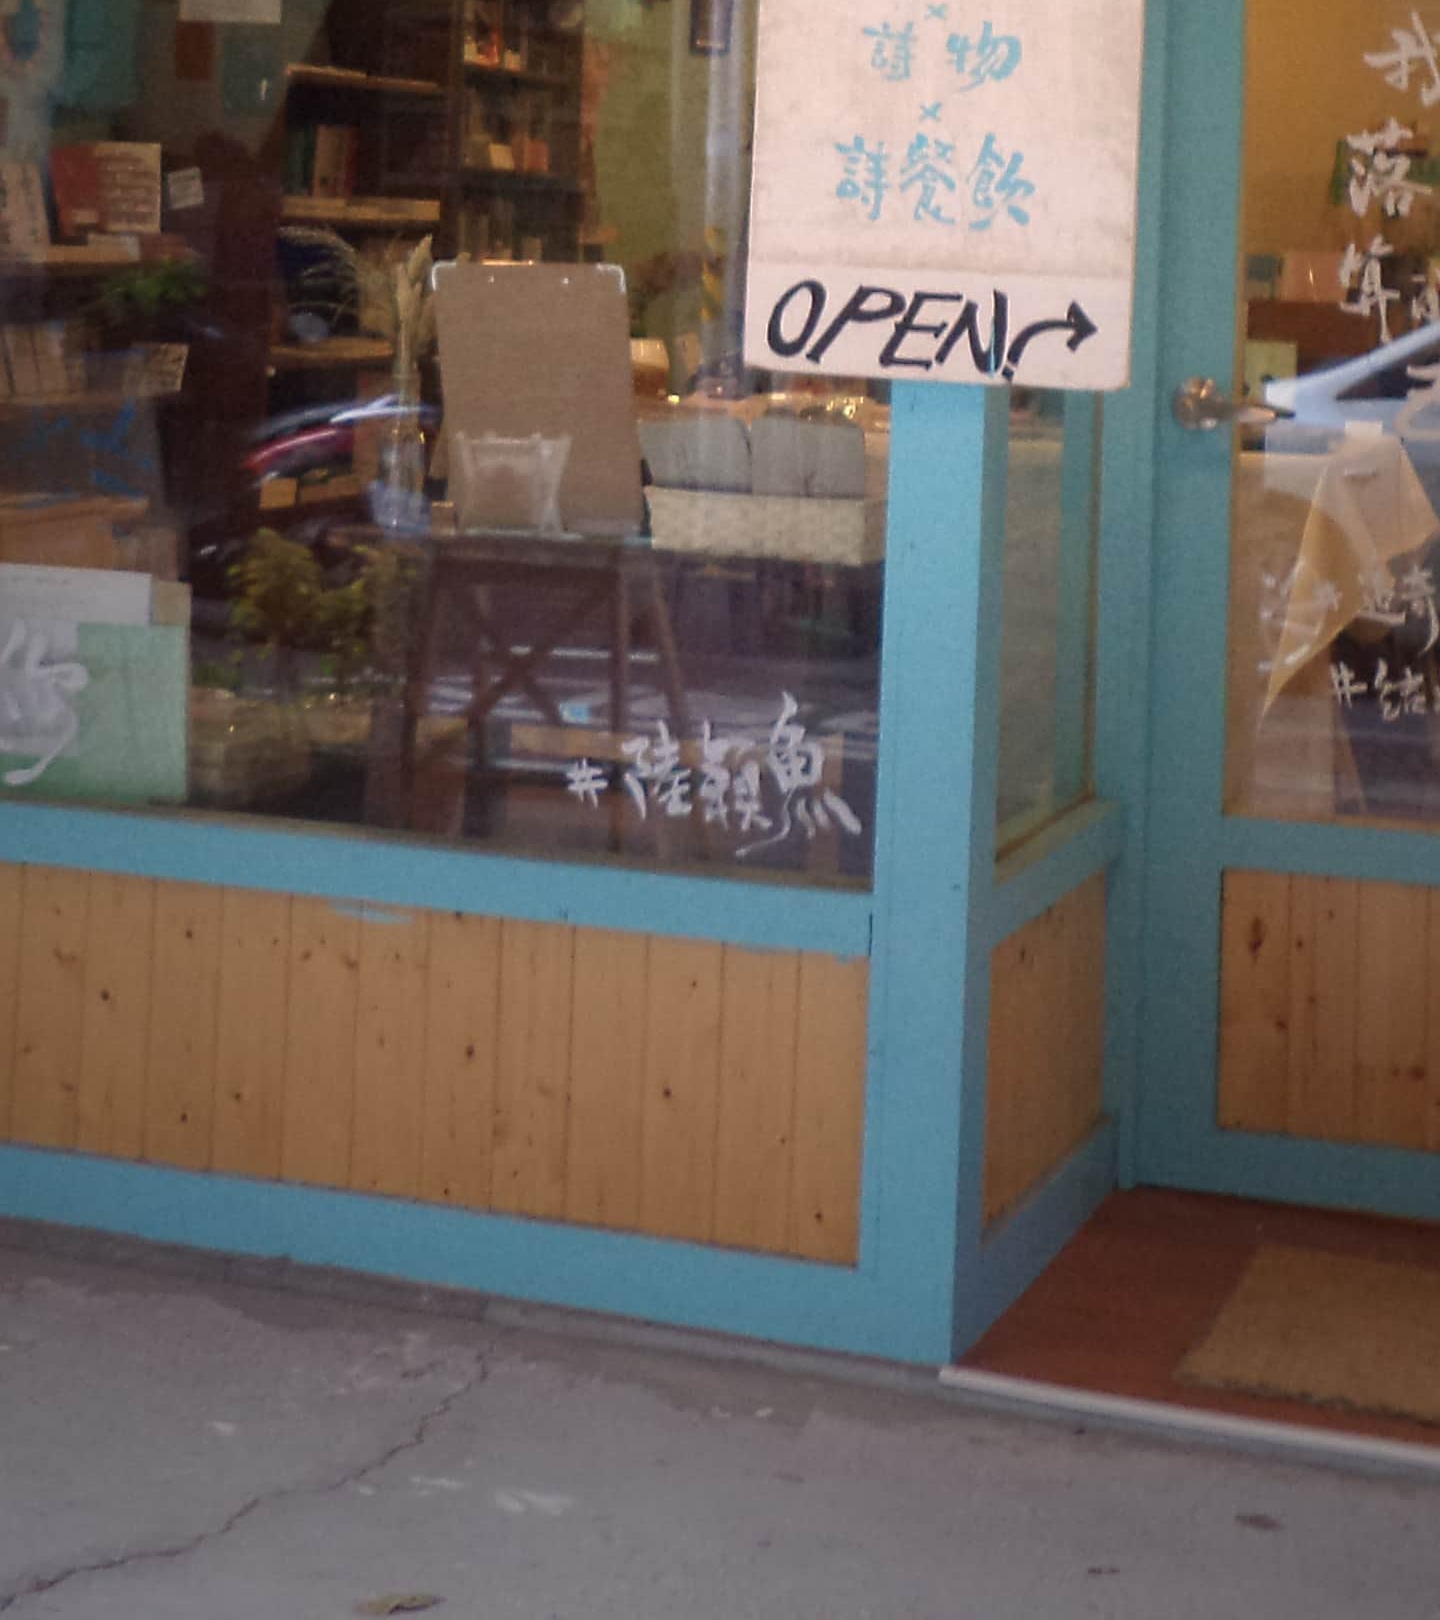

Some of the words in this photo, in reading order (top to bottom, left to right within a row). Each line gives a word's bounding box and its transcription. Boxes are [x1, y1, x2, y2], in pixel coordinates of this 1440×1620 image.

[861, 19, 1024, 93] 詩物
[833, 133, 1038, 232] 詩餐飲
[765, 278, 1010, 378] OPEN
